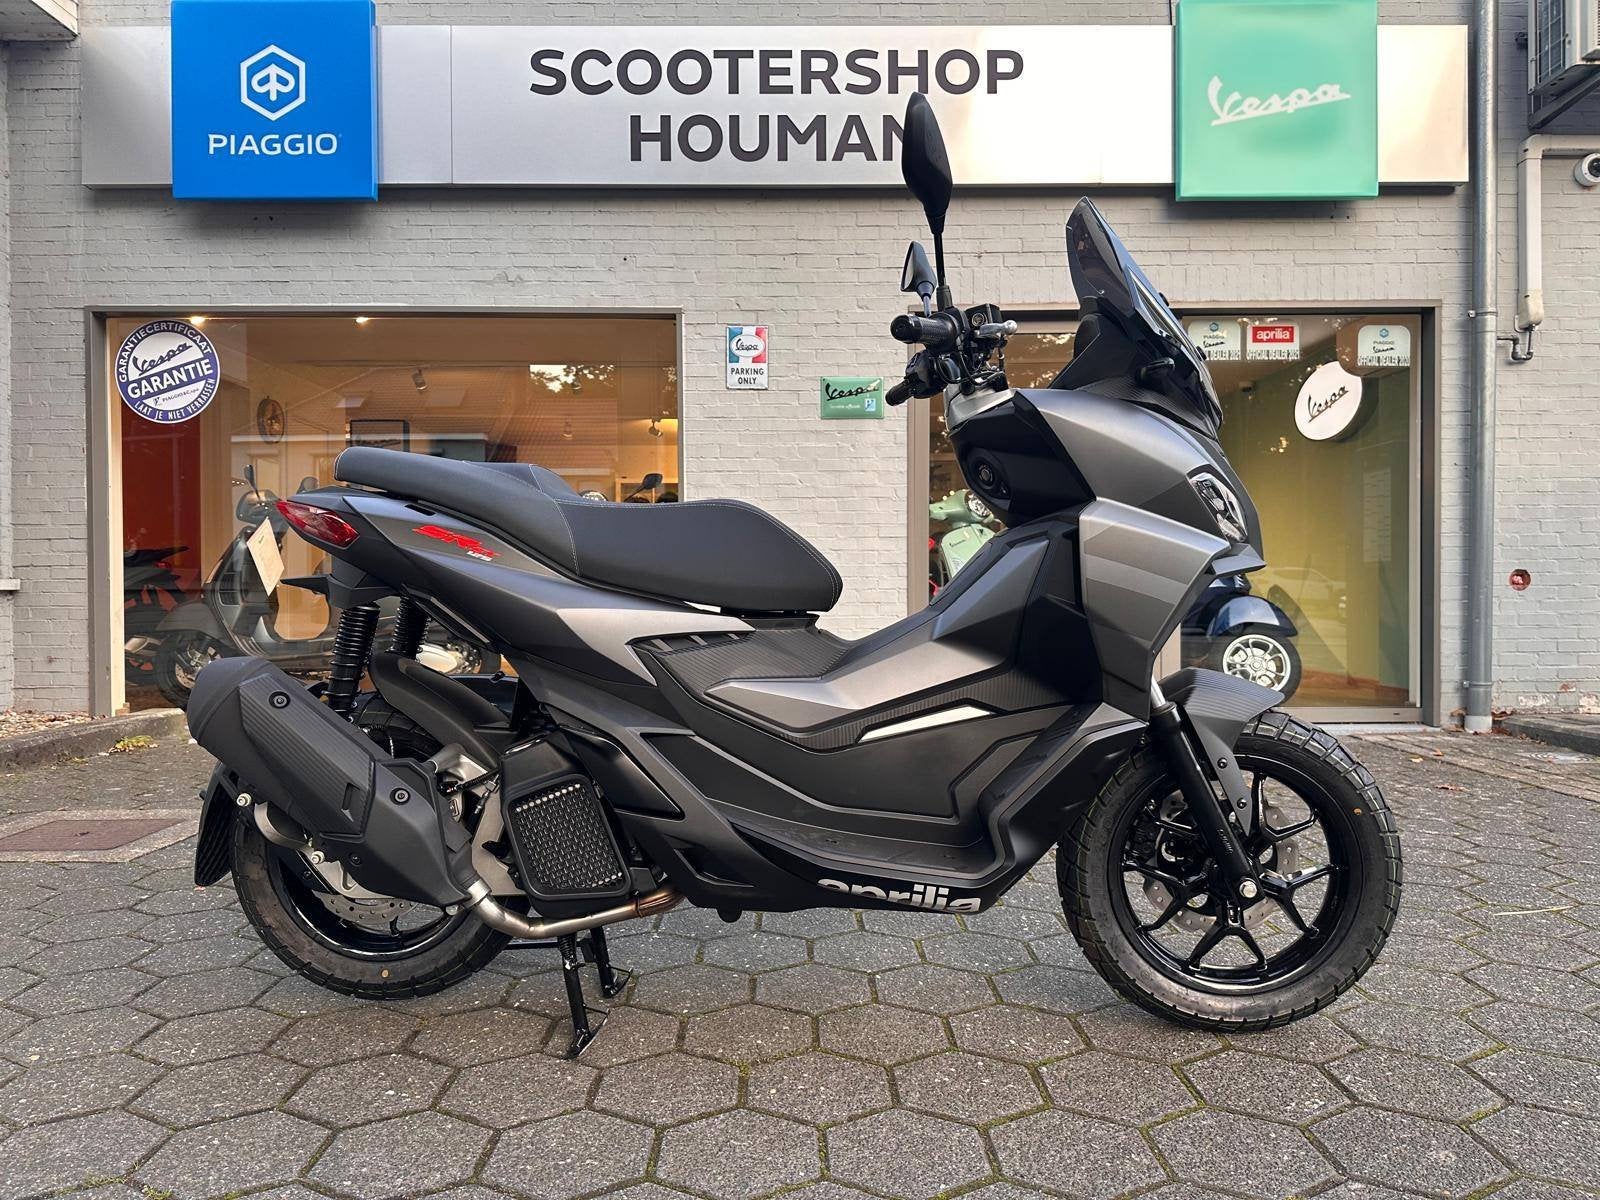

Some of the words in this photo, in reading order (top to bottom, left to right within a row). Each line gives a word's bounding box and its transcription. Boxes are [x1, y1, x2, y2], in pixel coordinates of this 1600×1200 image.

[529, 48, 1024, 96] SCOOTERSHOP
[1207, 75, 1352, 126] Vespa
[208, 133, 338, 156] PIAGGIO
[735, 338, 760, 352] Vespa
[1256, 328, 1290, 341] aprilia
[119, 322, 212, 383] GARANTIECERTIFICAAT
[132, 342, 193, 377] Vespa
[1269, 349, 1288, 360] DEALER
[1379, 356, 1398, 366] DEALER
[127, 358, 214, 399] GARANTIE
[731, 367, 764, 376] PARKING
[737, 377, 757, 385] ONLY
[134, 401, 153, 416] LAAT
[154, 410, 164, 420] JE
[167, 409, 186, 420] NIET
[187, 379, 216, 412] VERRASSEN
[1308, 386, 1349, 423] Vespa
